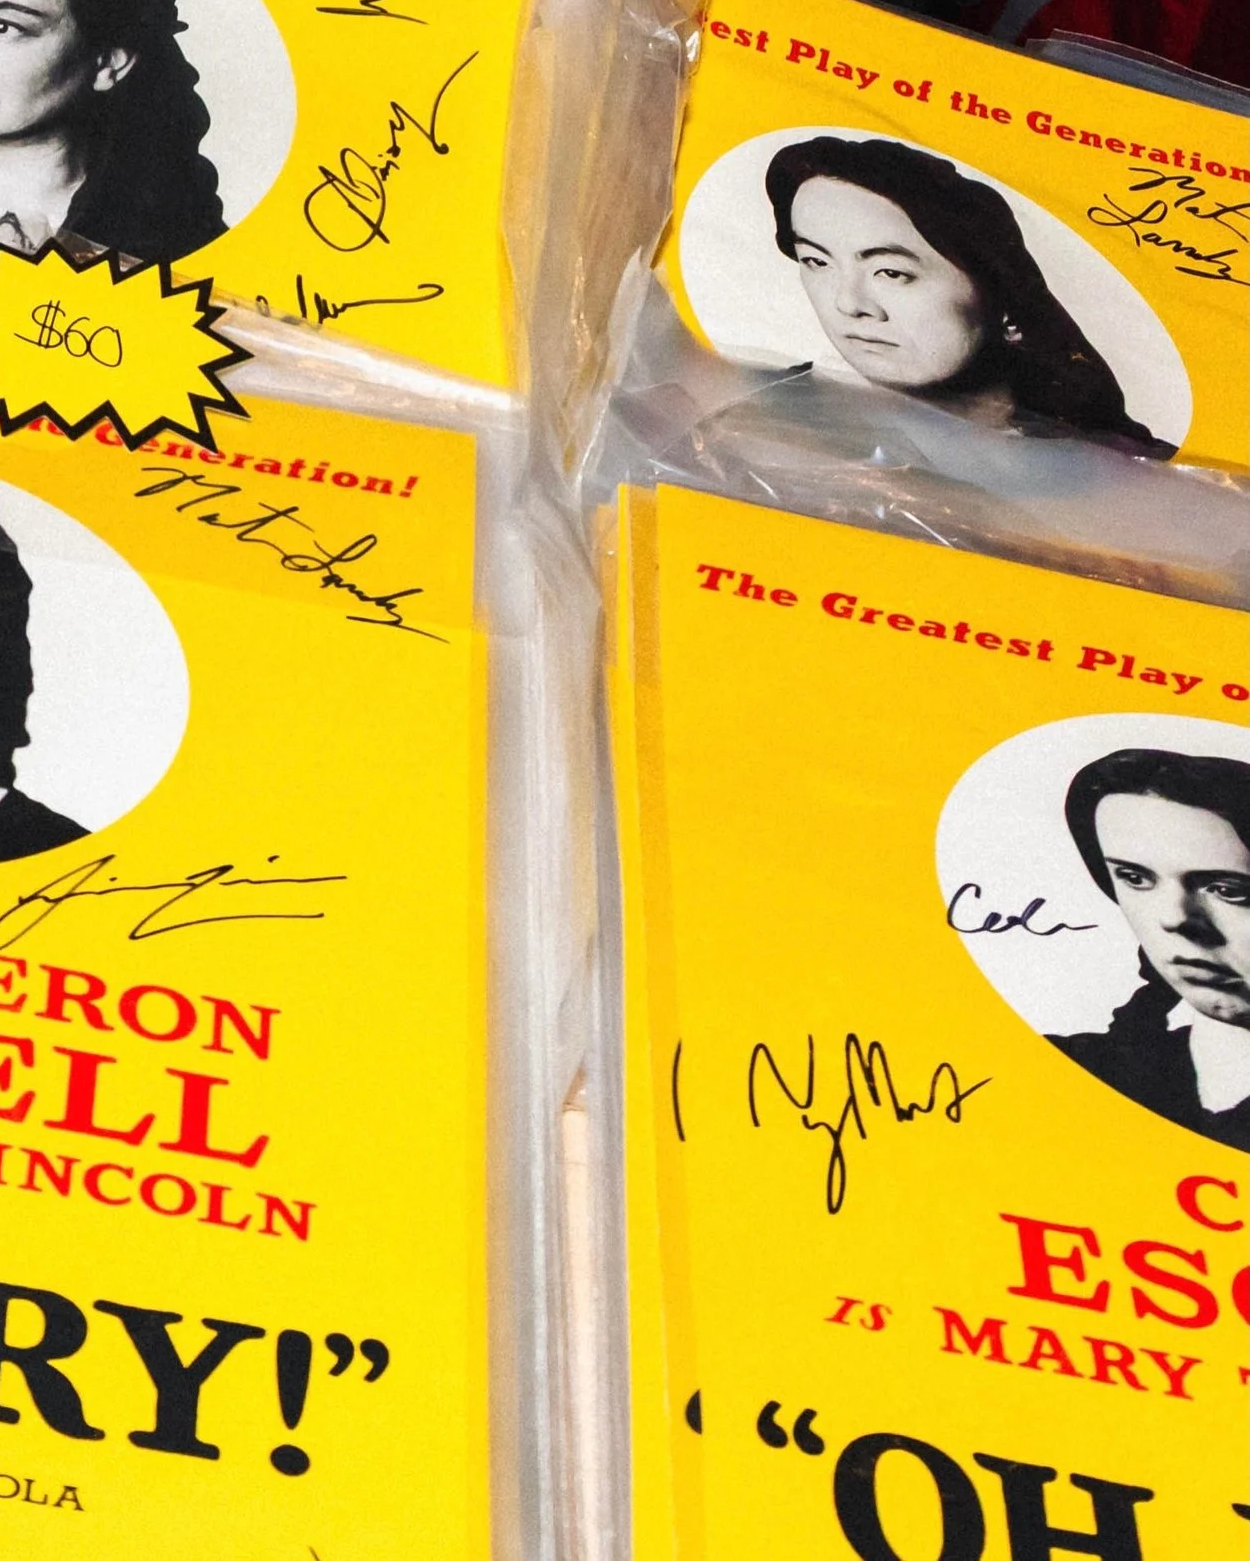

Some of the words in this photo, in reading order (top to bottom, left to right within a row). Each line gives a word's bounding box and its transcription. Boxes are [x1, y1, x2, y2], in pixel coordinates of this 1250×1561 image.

[785, 38, 880, 90] Play
[892, 79, 933, 103] of
[950, 90, 1012, 125] the
[1025, 110, 1250, 184] Generation
[14, 300, 124, 368] $60
[696, 563, 799, 607] The
[820, 591, 1054, 662] Greatest
[1076, 646, 1204, 696] Play
[1220, 682, 1250, 702] o
[825, 1296, 893, 1332] IS
[934, 1306, 1202, 1400] MARY
